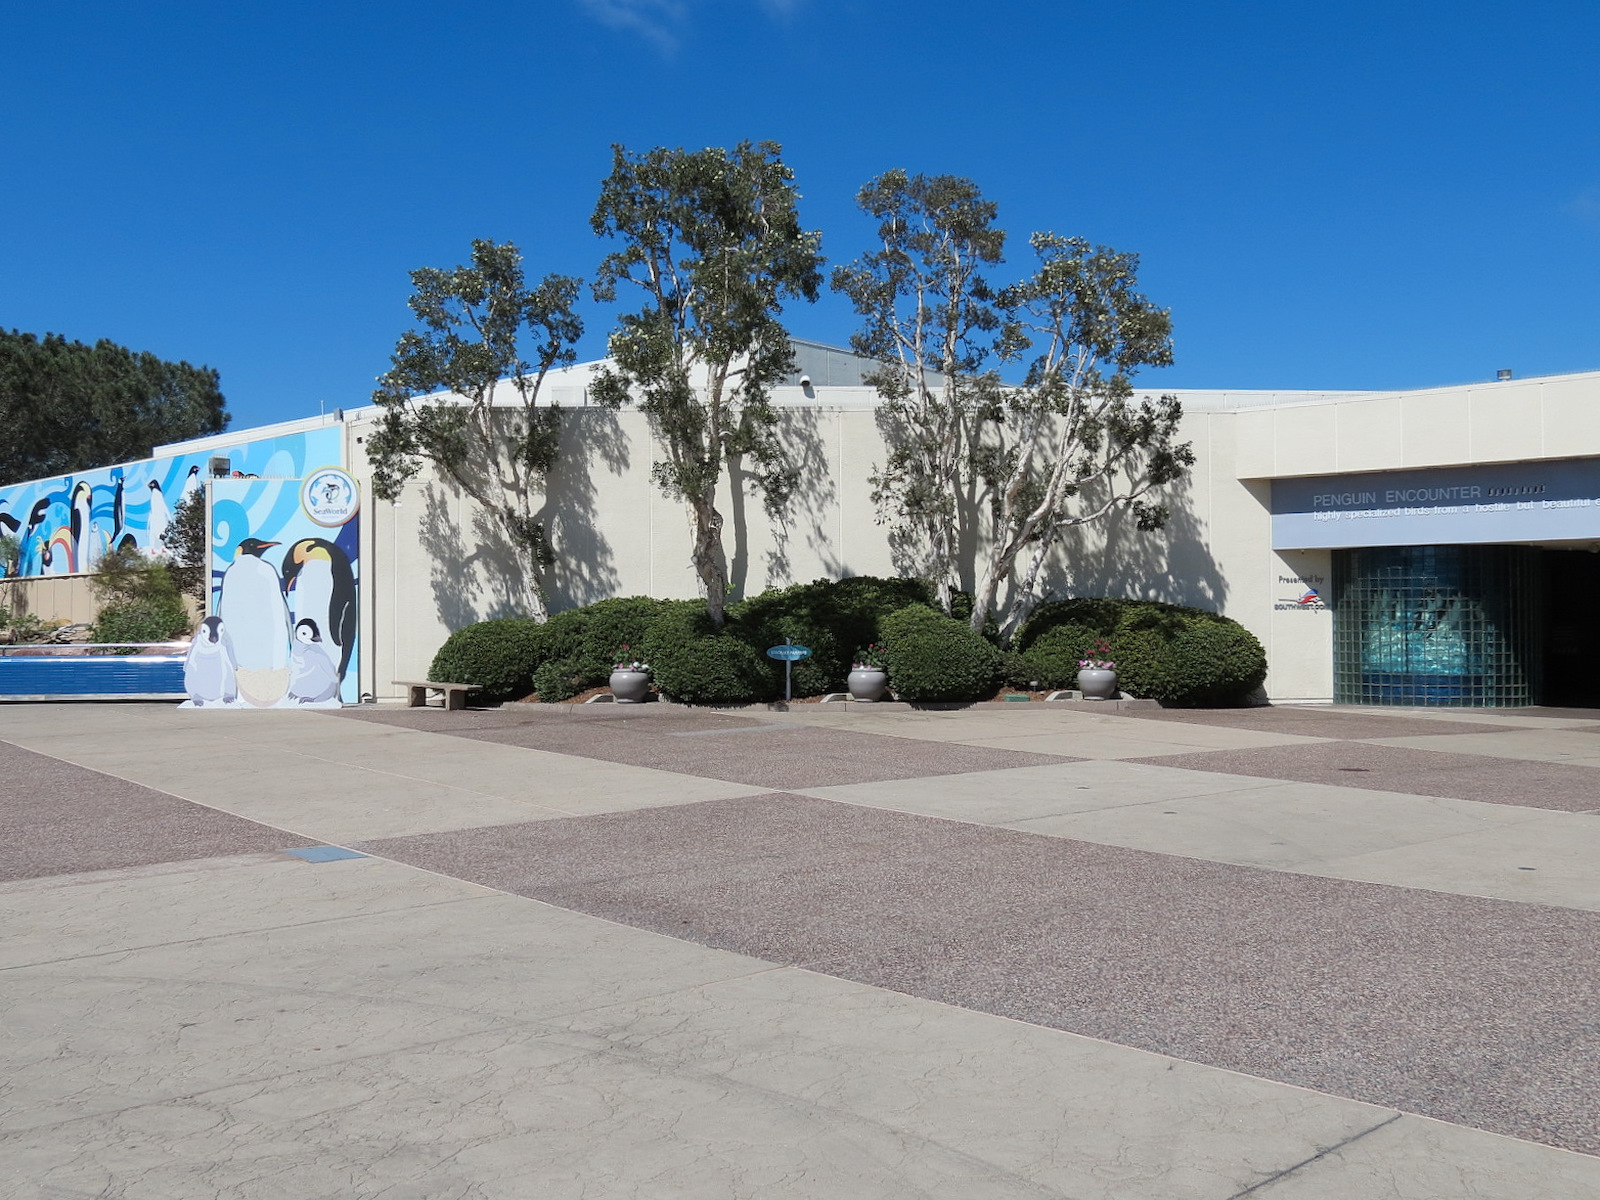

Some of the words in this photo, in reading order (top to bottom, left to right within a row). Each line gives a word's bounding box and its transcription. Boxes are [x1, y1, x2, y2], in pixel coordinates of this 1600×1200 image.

[1313, 492, 1376, 506] PENGUIN
[1386, 486, 1481, 502] ENCOUNTER
[1313, 510, 1341, 522] highly
[1345, 508, 1400, 520] specialized
[1404, 507, 1429, 517] birds
[1434, 505, 1457, 515] from
[1463, 505, 1470, 513] a
[1475, 502, 1510, 513] hostile
[1517, 501, 1534, 510] but
[1542, 498, 1591, 509] beautiful
[1278, 575, 1312, 583] Presented
[1315, 575, 1324, 584] by
